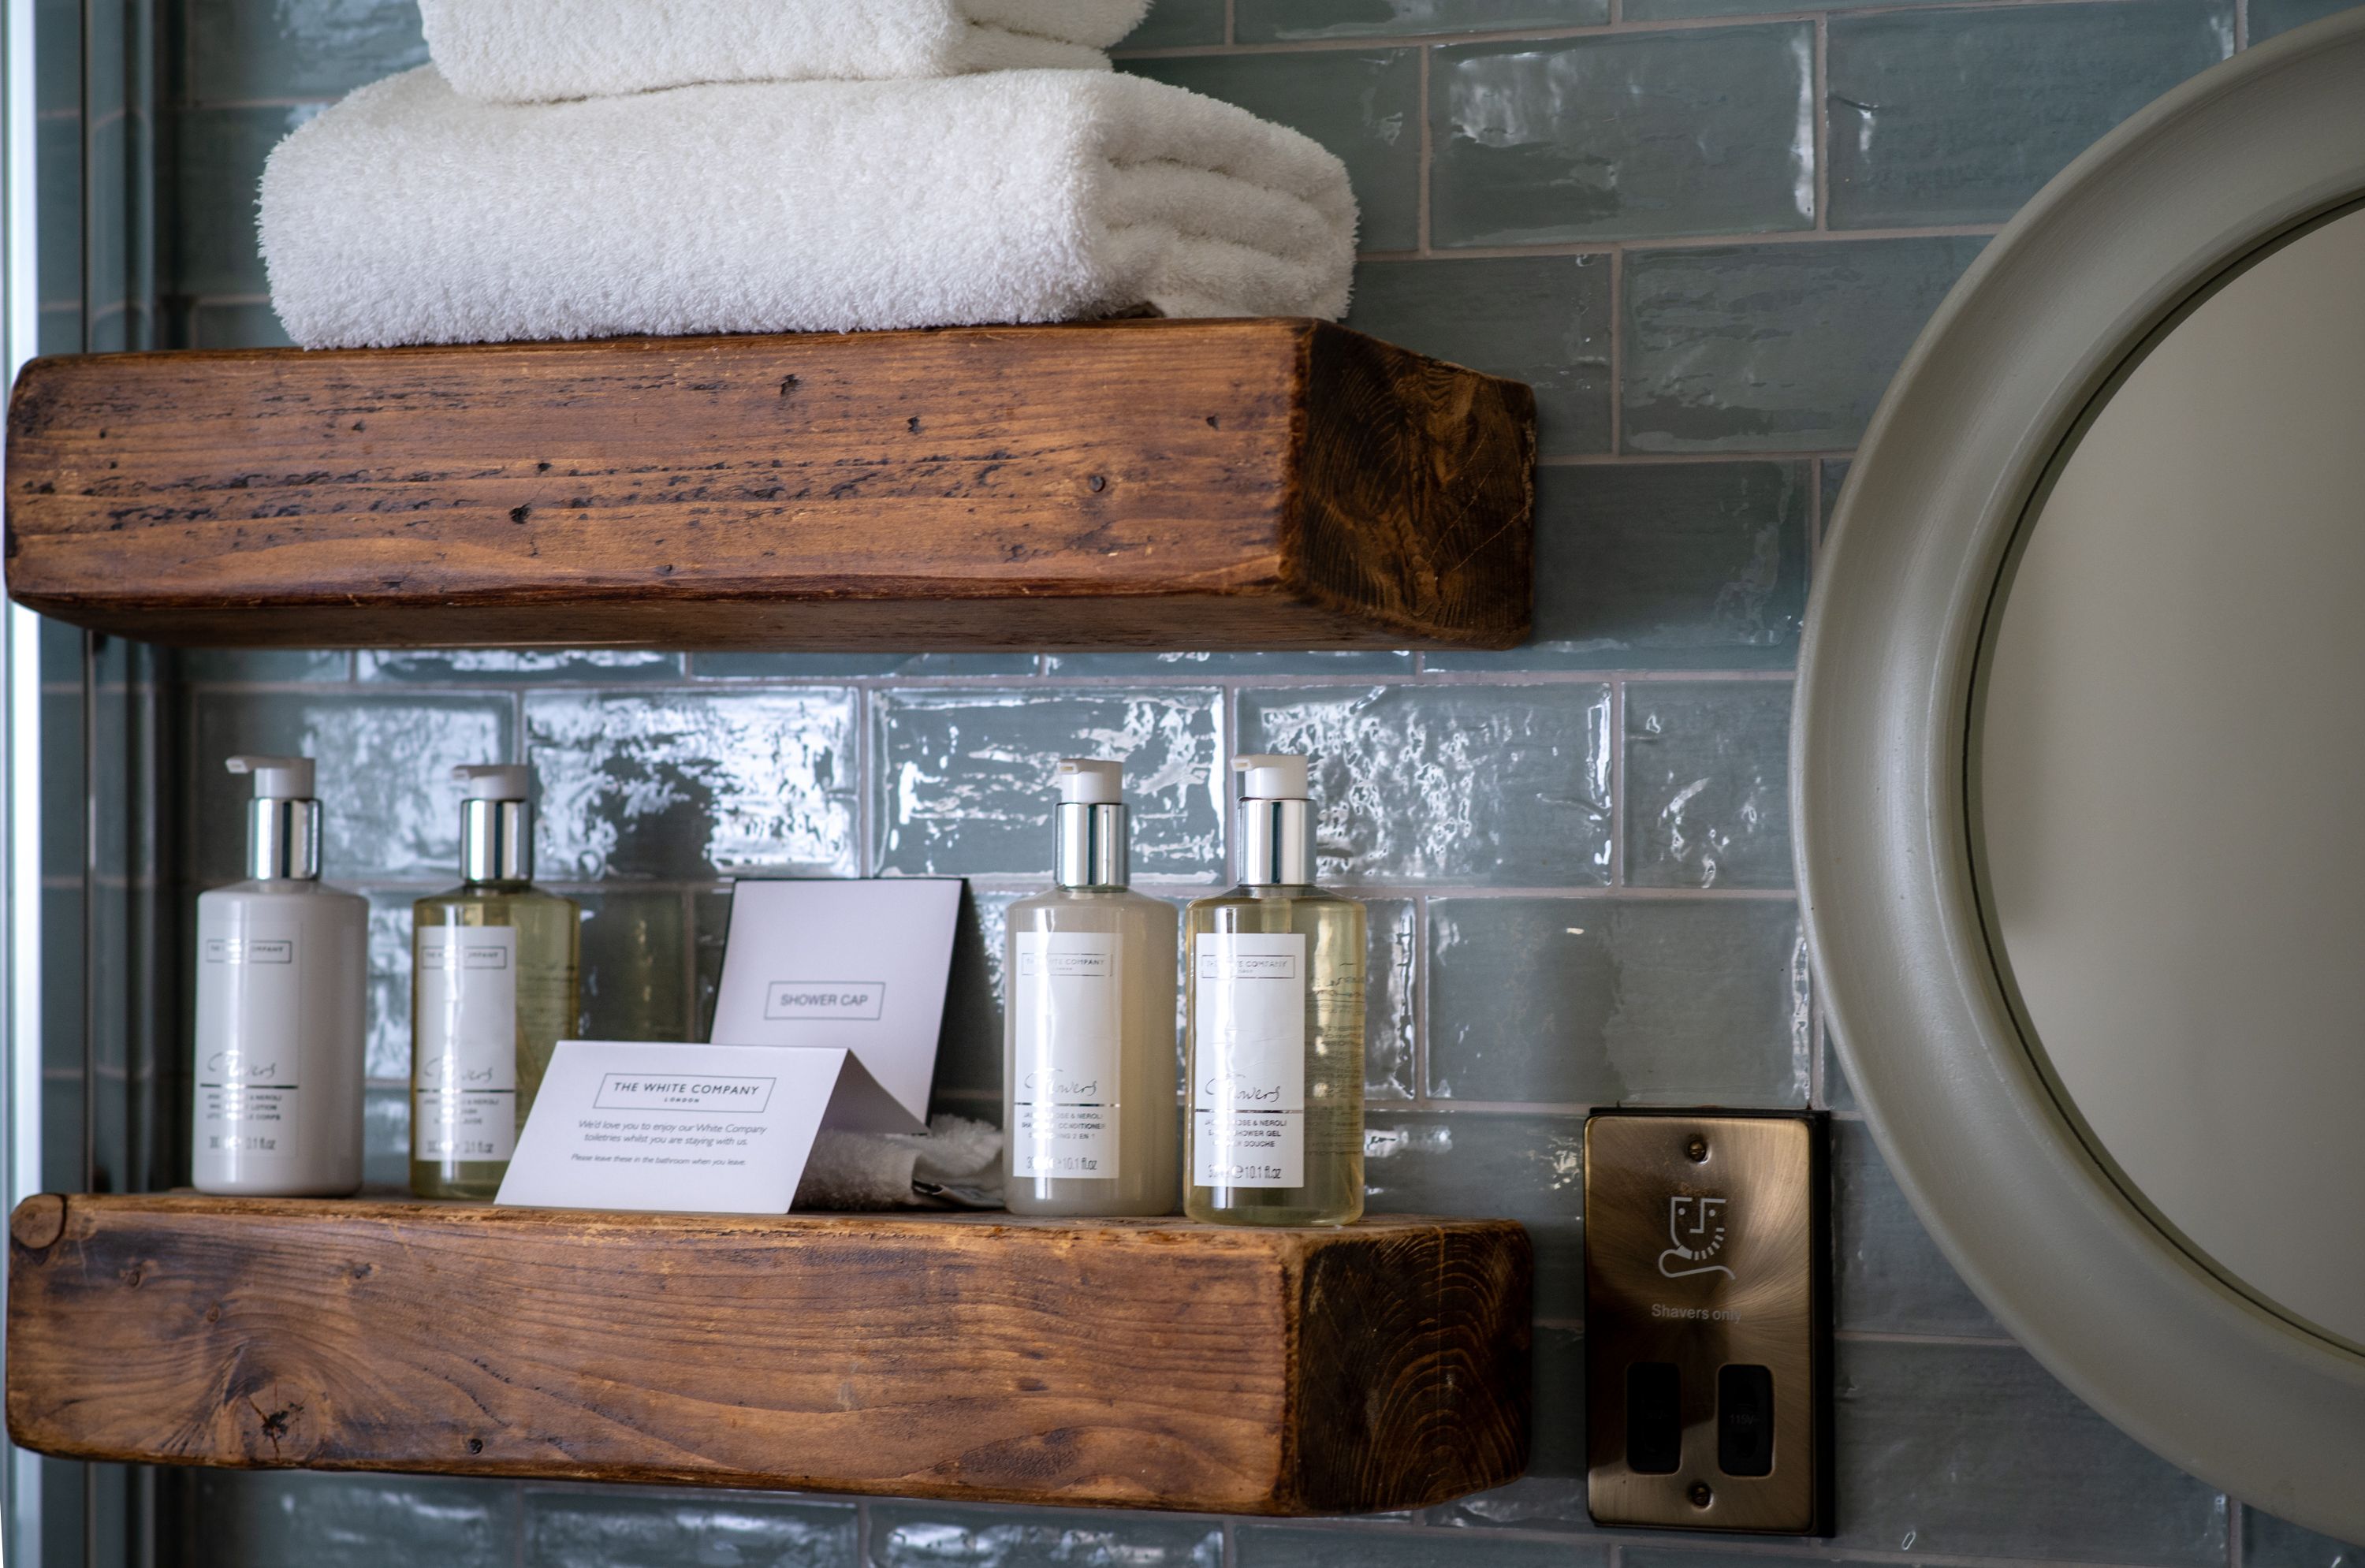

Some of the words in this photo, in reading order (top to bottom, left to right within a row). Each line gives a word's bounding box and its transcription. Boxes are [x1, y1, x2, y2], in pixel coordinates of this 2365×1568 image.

[780, 993, 837, 1006] SHOWER
[840, 994, 869, 1006] CAP
[613, 1082, 639, 1092] THE
[643, 1083, 687, 1093] WHITE
[691, 1085, 760, 1095] COMPANY
[602, 1121, 620, 1130] love
[622, 1123, 639, 1131] you
[653, 1123, 676, 1133] enjoy
[695, 1123, 723, 1132] White
[724, 1124, 767, 1134] Company
[584, 1133, 621, 1142] toiletries
[624, 1134, 648, 1142] whilst
[650, 1136, 666, 1145] you
[685, 1136, 713, 1147] staying
[716, 1137, 735, 1145] with
[1652, 1304, 1709, 1320] Shavers
[1712, 1308, 1741, 1324] only
